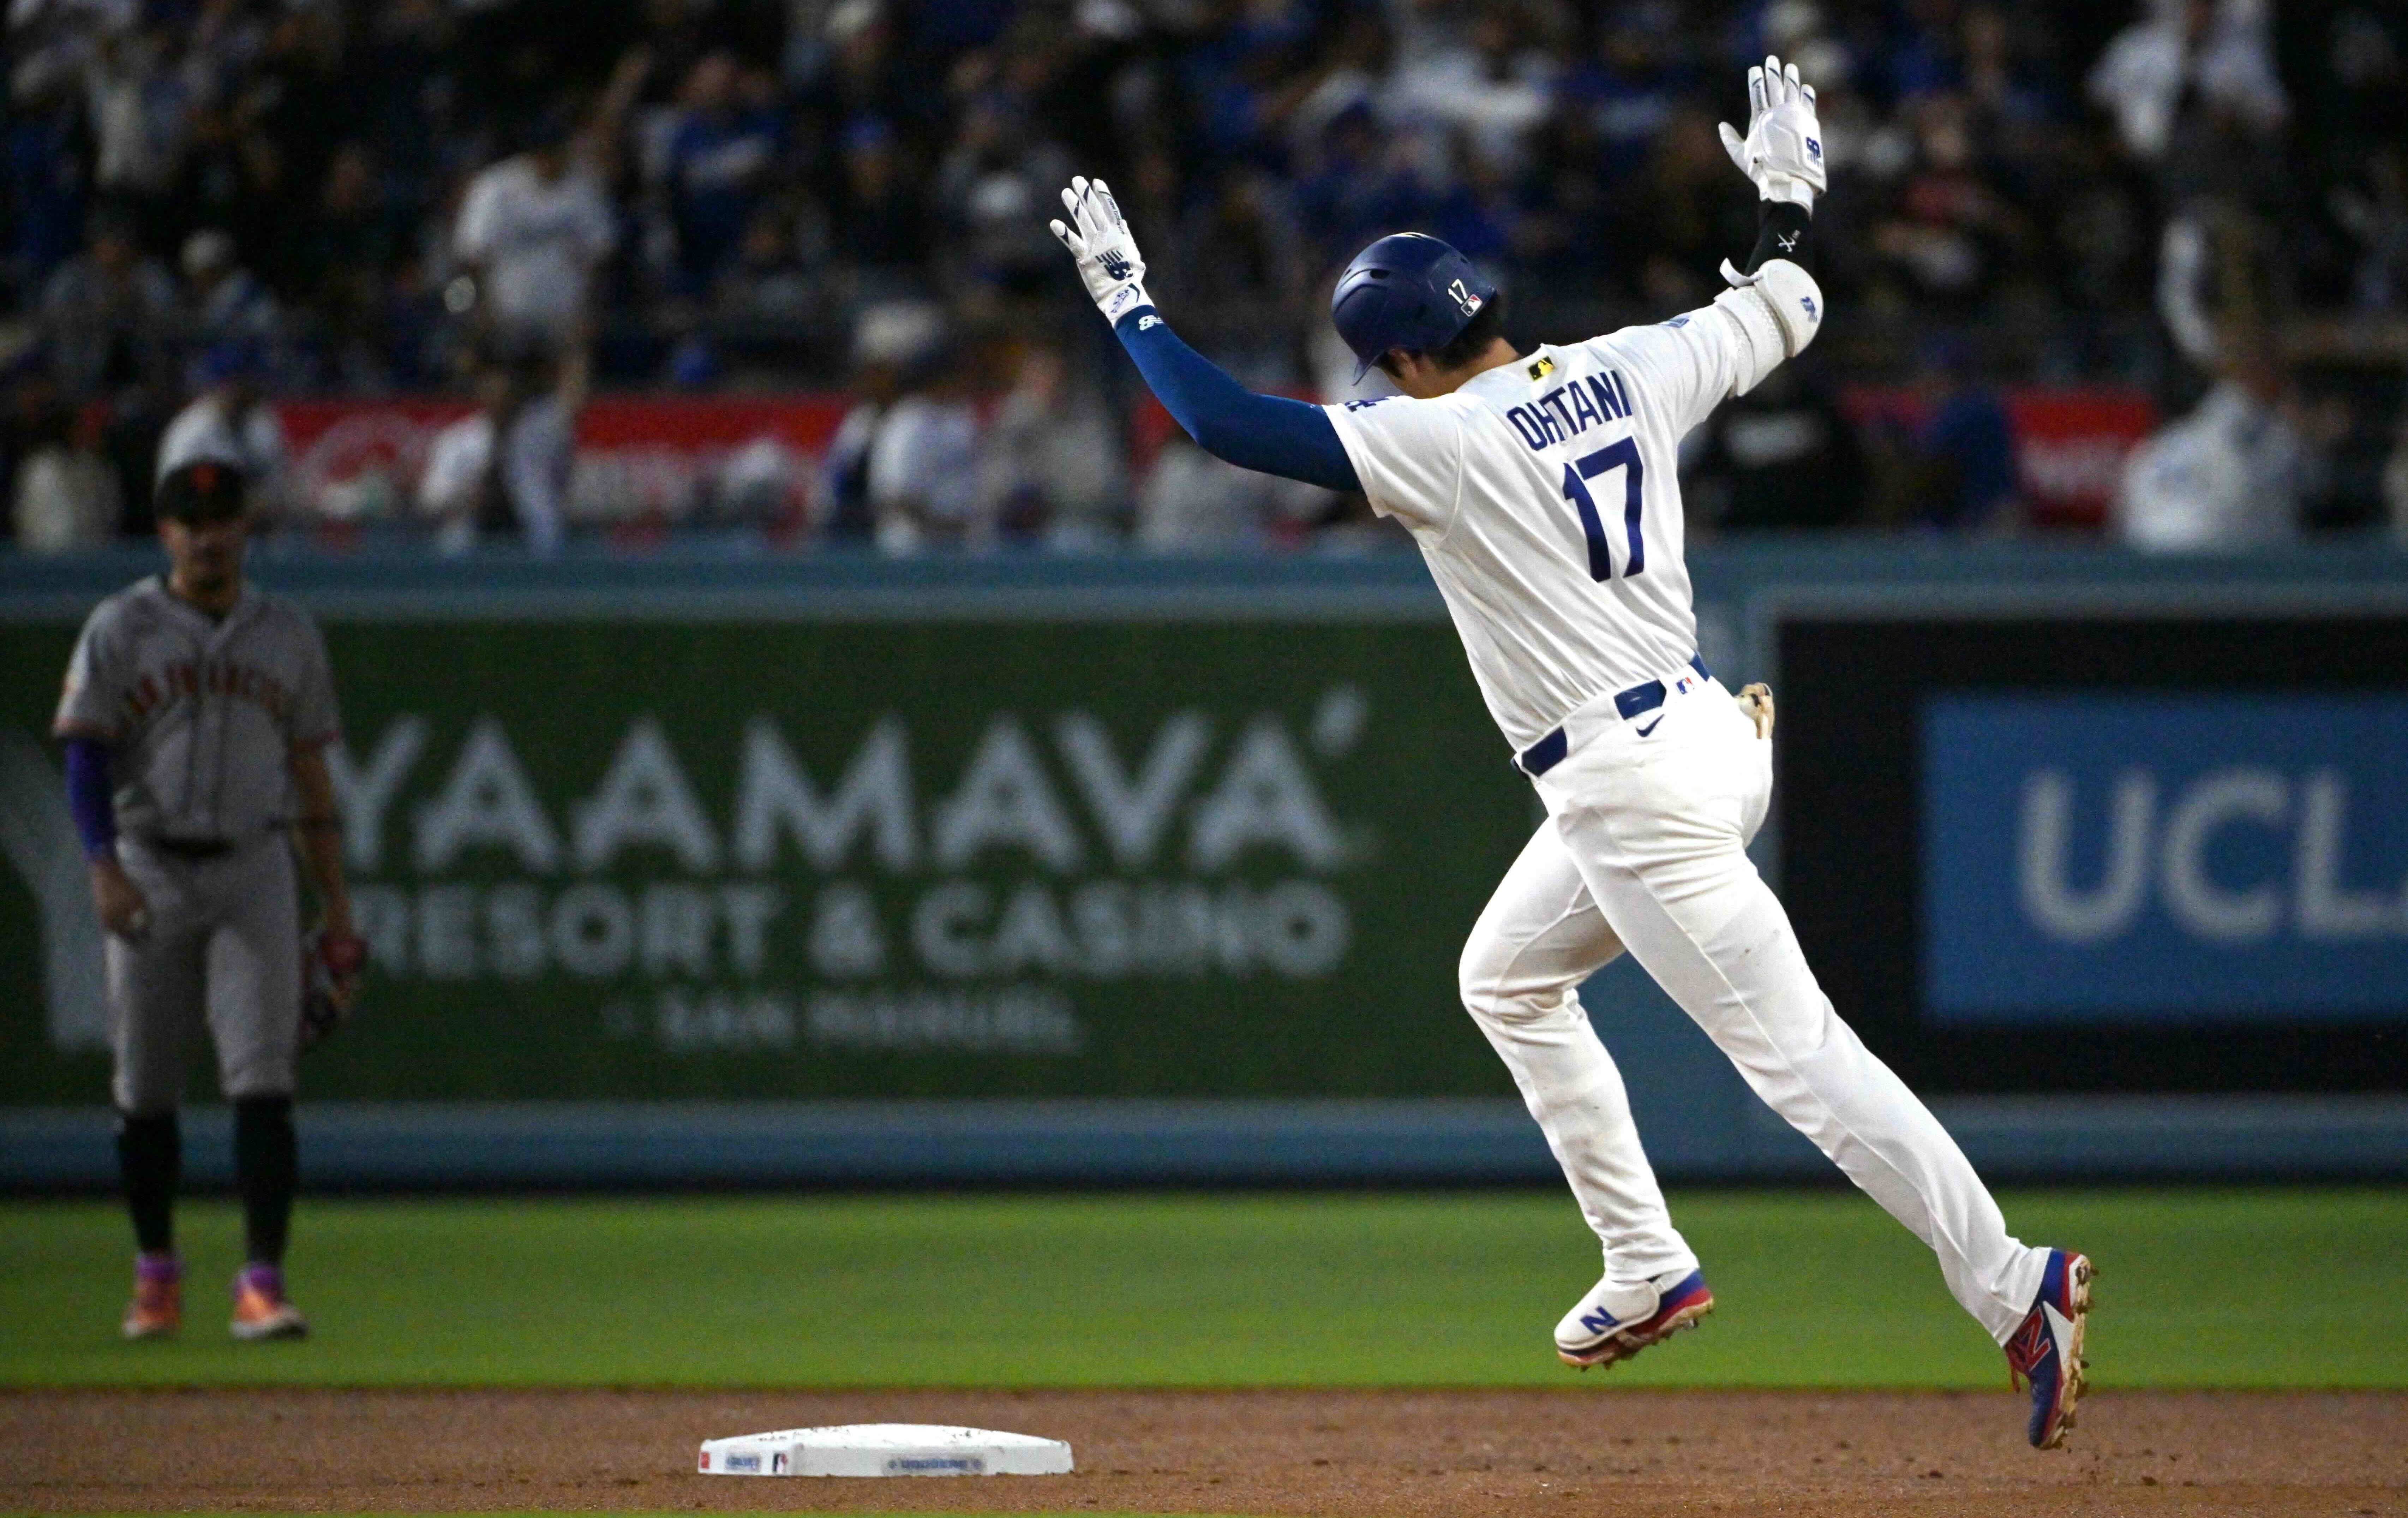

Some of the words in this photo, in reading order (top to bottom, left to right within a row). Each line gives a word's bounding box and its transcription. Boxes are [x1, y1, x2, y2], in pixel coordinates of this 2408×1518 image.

[1448, 279, 1468, 304] 17
[1507, 370, 1633, 451] OHTANI
[1563, 436, 1644, 582] 17
[2017, 768, 2408, 941] UCL
[348, 878, 781, 981] RESORT
[807, 878, 885, 981] &
[910, 878, 1354, 981] CASINO
